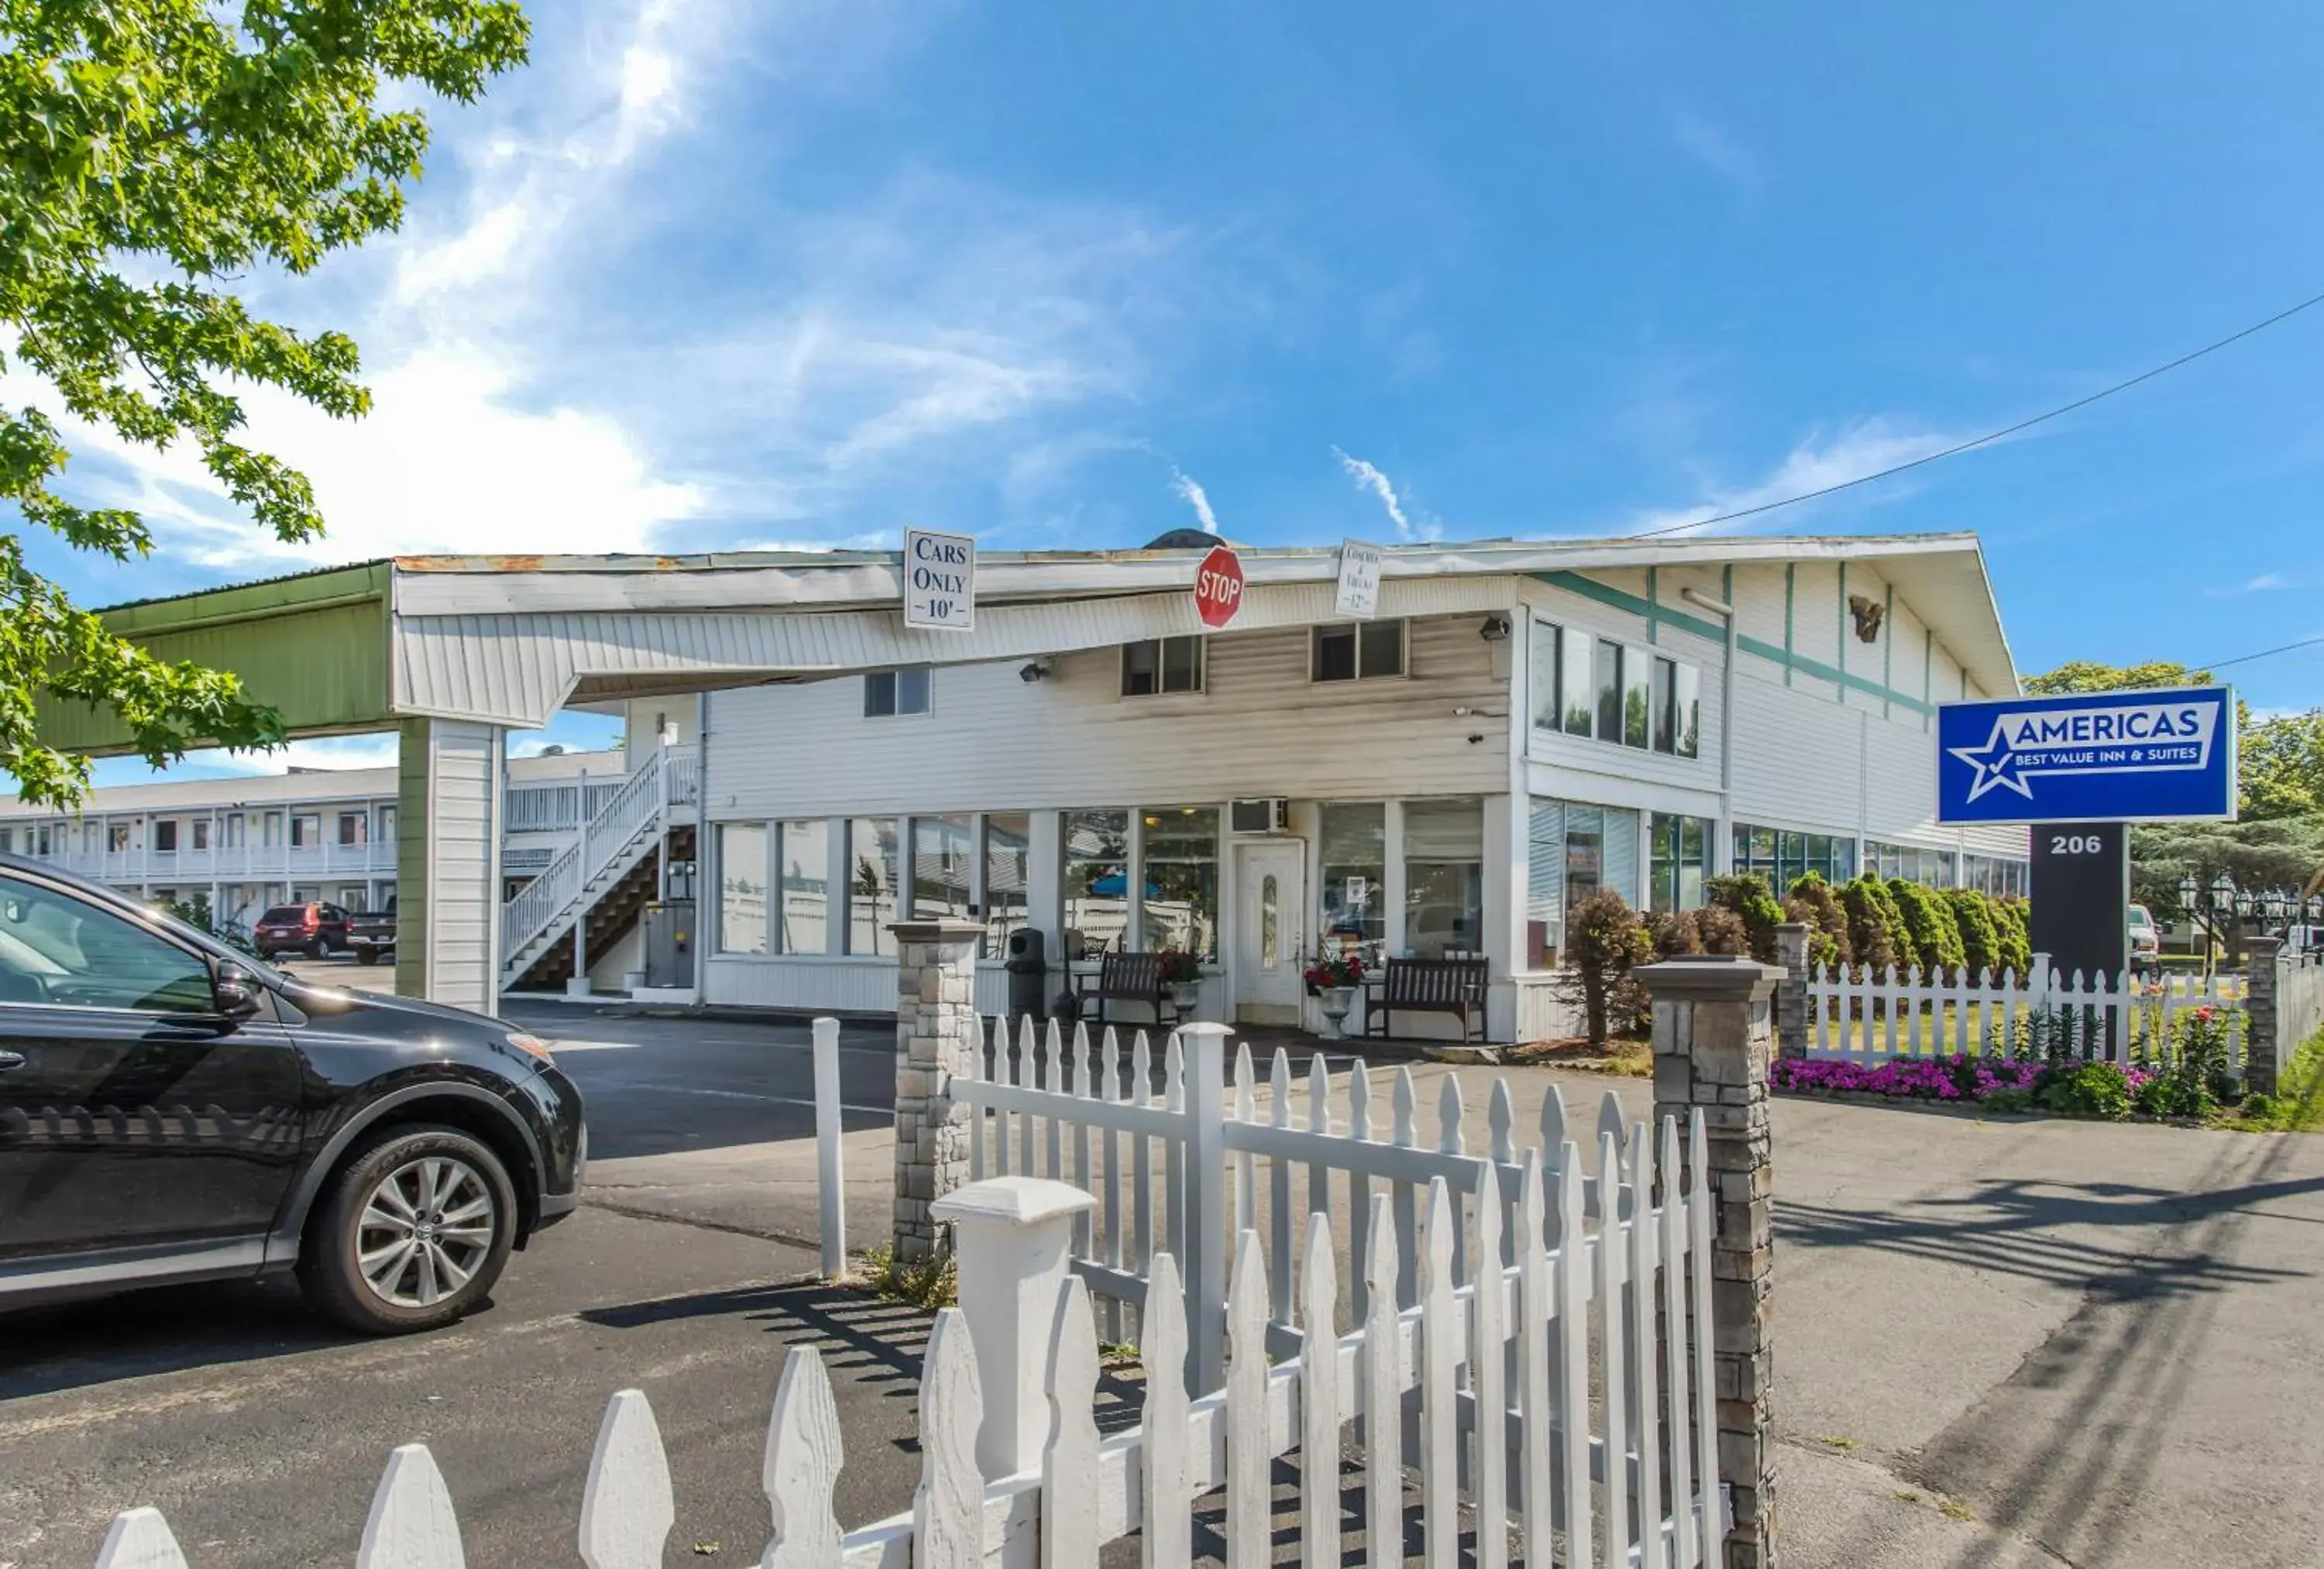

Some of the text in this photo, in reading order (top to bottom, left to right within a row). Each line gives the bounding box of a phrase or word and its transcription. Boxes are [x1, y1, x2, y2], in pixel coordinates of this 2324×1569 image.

[916, 537, 966, 564] CARS
[914, 567, 966, 593] ONLY
[1198, 570, 1239, 605] STOP
[2015, 709, 2199, 743] AMERICAS
[2016, 747, 2197, 766] BEST VALUE INN & SUITES
[2051, 836, 2102, 854] 206
